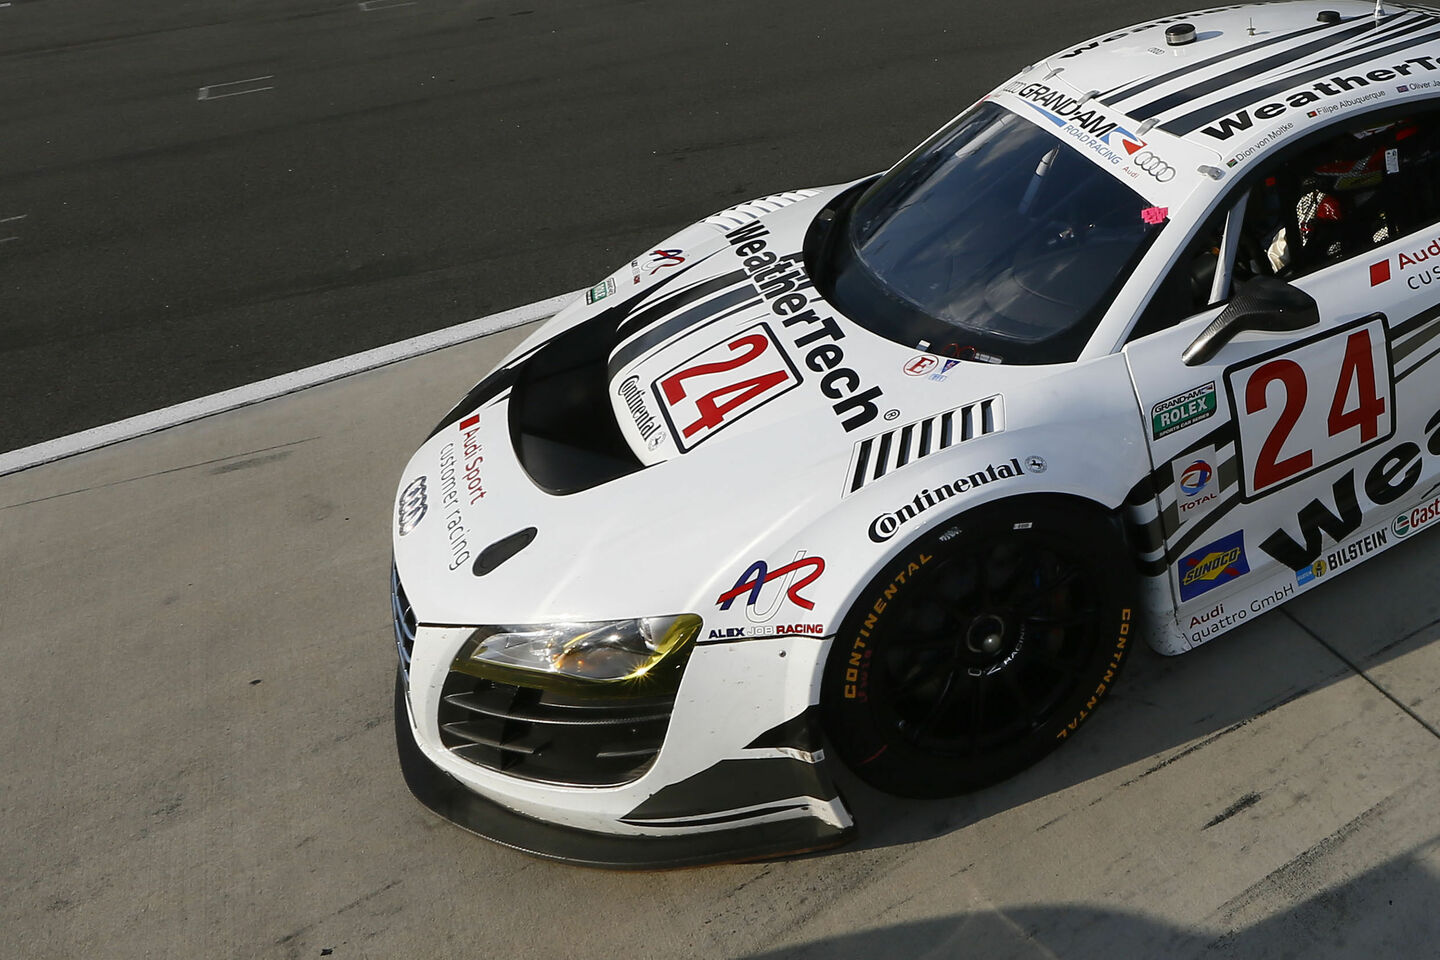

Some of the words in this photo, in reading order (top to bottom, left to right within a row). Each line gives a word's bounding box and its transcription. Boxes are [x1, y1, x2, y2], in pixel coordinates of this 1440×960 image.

[1316, 102, 1340, 116] Filipe
[1340, 90, 1386, 110] Albuquerque
[1409, 80, 1431, 91] Oliver
[1064, 124, 1091, 145] ROAD
[1087, 140, 1124, 165] RACING
[1235, 144, 1255, 162] Dion
[1254, 136, 1269, 148] von
[1269, 122, 1294, 140] Moltke
[1122, 166, 1139, 179] Audi
[726, 221, 886, 433] WeatherTech
[906, 356, 936, 374] E
[616, 374, 663, 441] Continental
[661, 334, 792, 440] 24
[1160, 396, 1208, 428] ROLEX
[1244, 328, 1386, 492] 24
[463, 427, 482, 458] Audi
[439, 441, 460, 508] customer
[463, 456, 487, 506] Sport
[868, 458, 1025, 544] Continental
[1180, 493, 1218, 513] TOTAL
[444, 508, 471, 572] racing
[1328, 529, 1387, 572] BILSTEIN
[1183, 547, 1241, 586] SUNOCO
[709, 626, 745, 638] ALEX
[746, 624, 775, 636] JOB
[776, 623, 824, 635] RACING
[844, 552, 933, 700] CONTINENTAL
[1189, 603, 1225, 629] Audi
[1192, 608, 1247, 643] quattro
[1249, 583, 1295, 613] GmbH
[1056, 607, 1132, 743] CONTINENTAL
